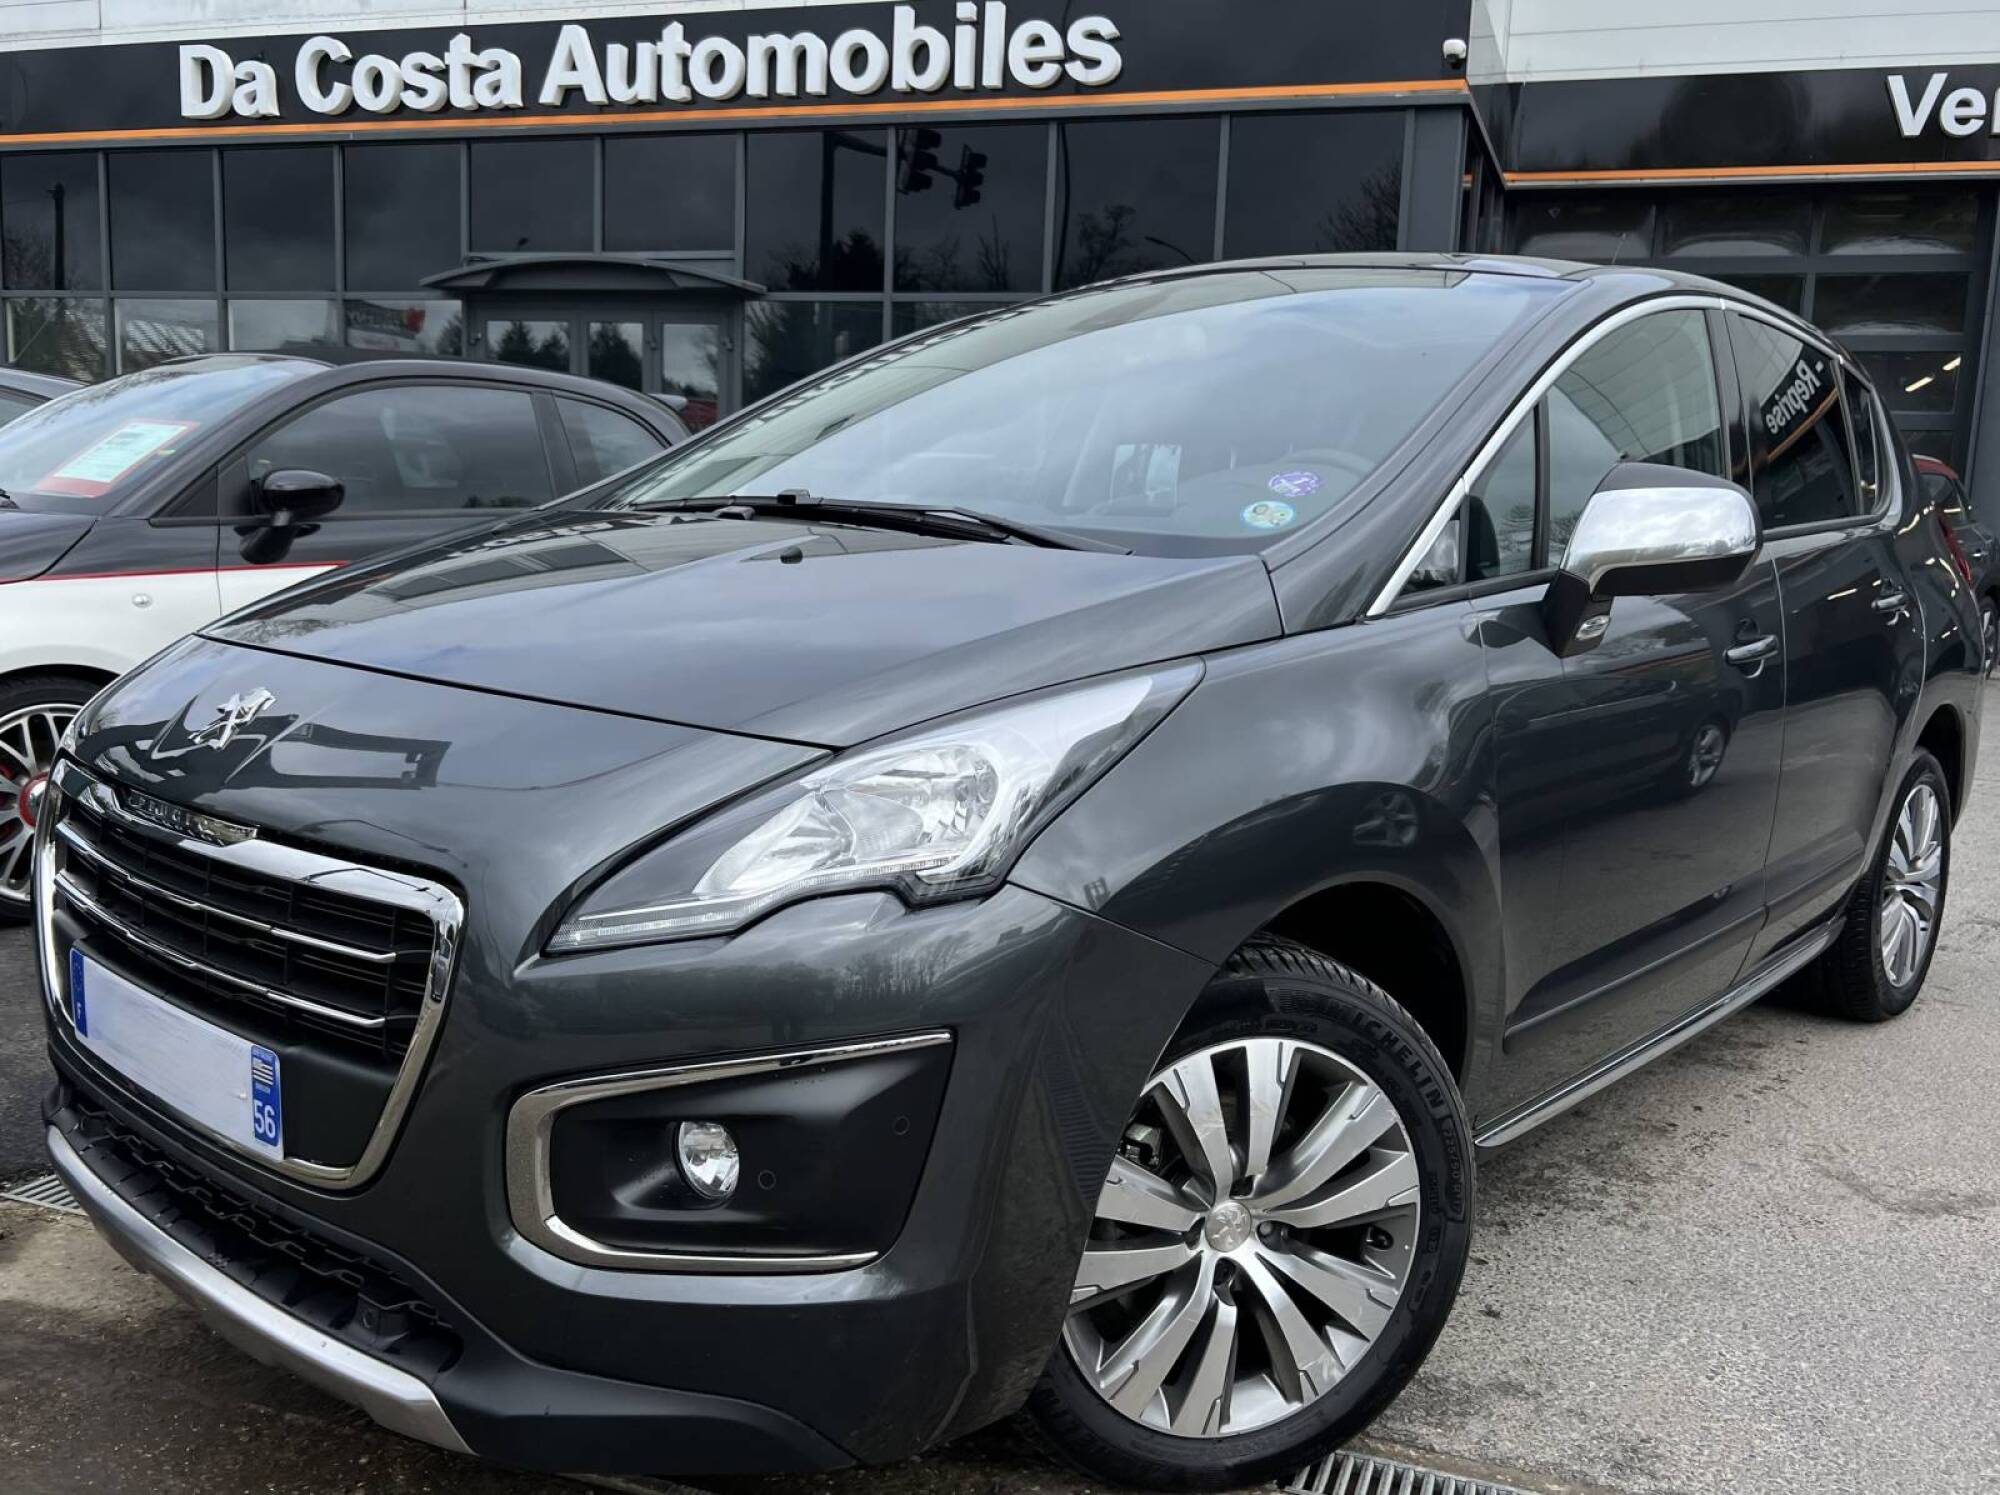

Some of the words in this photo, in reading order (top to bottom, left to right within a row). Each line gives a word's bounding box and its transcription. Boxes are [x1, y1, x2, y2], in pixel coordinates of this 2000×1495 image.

[180, 44, 280, 119] Da
[295, 34, 524, 116] Costa
[539, 0, 1122, 106] Automobiles
[1327, 1000, 1444, 1110] MICHELIN
[253, 1098, 277, 1139] 56
